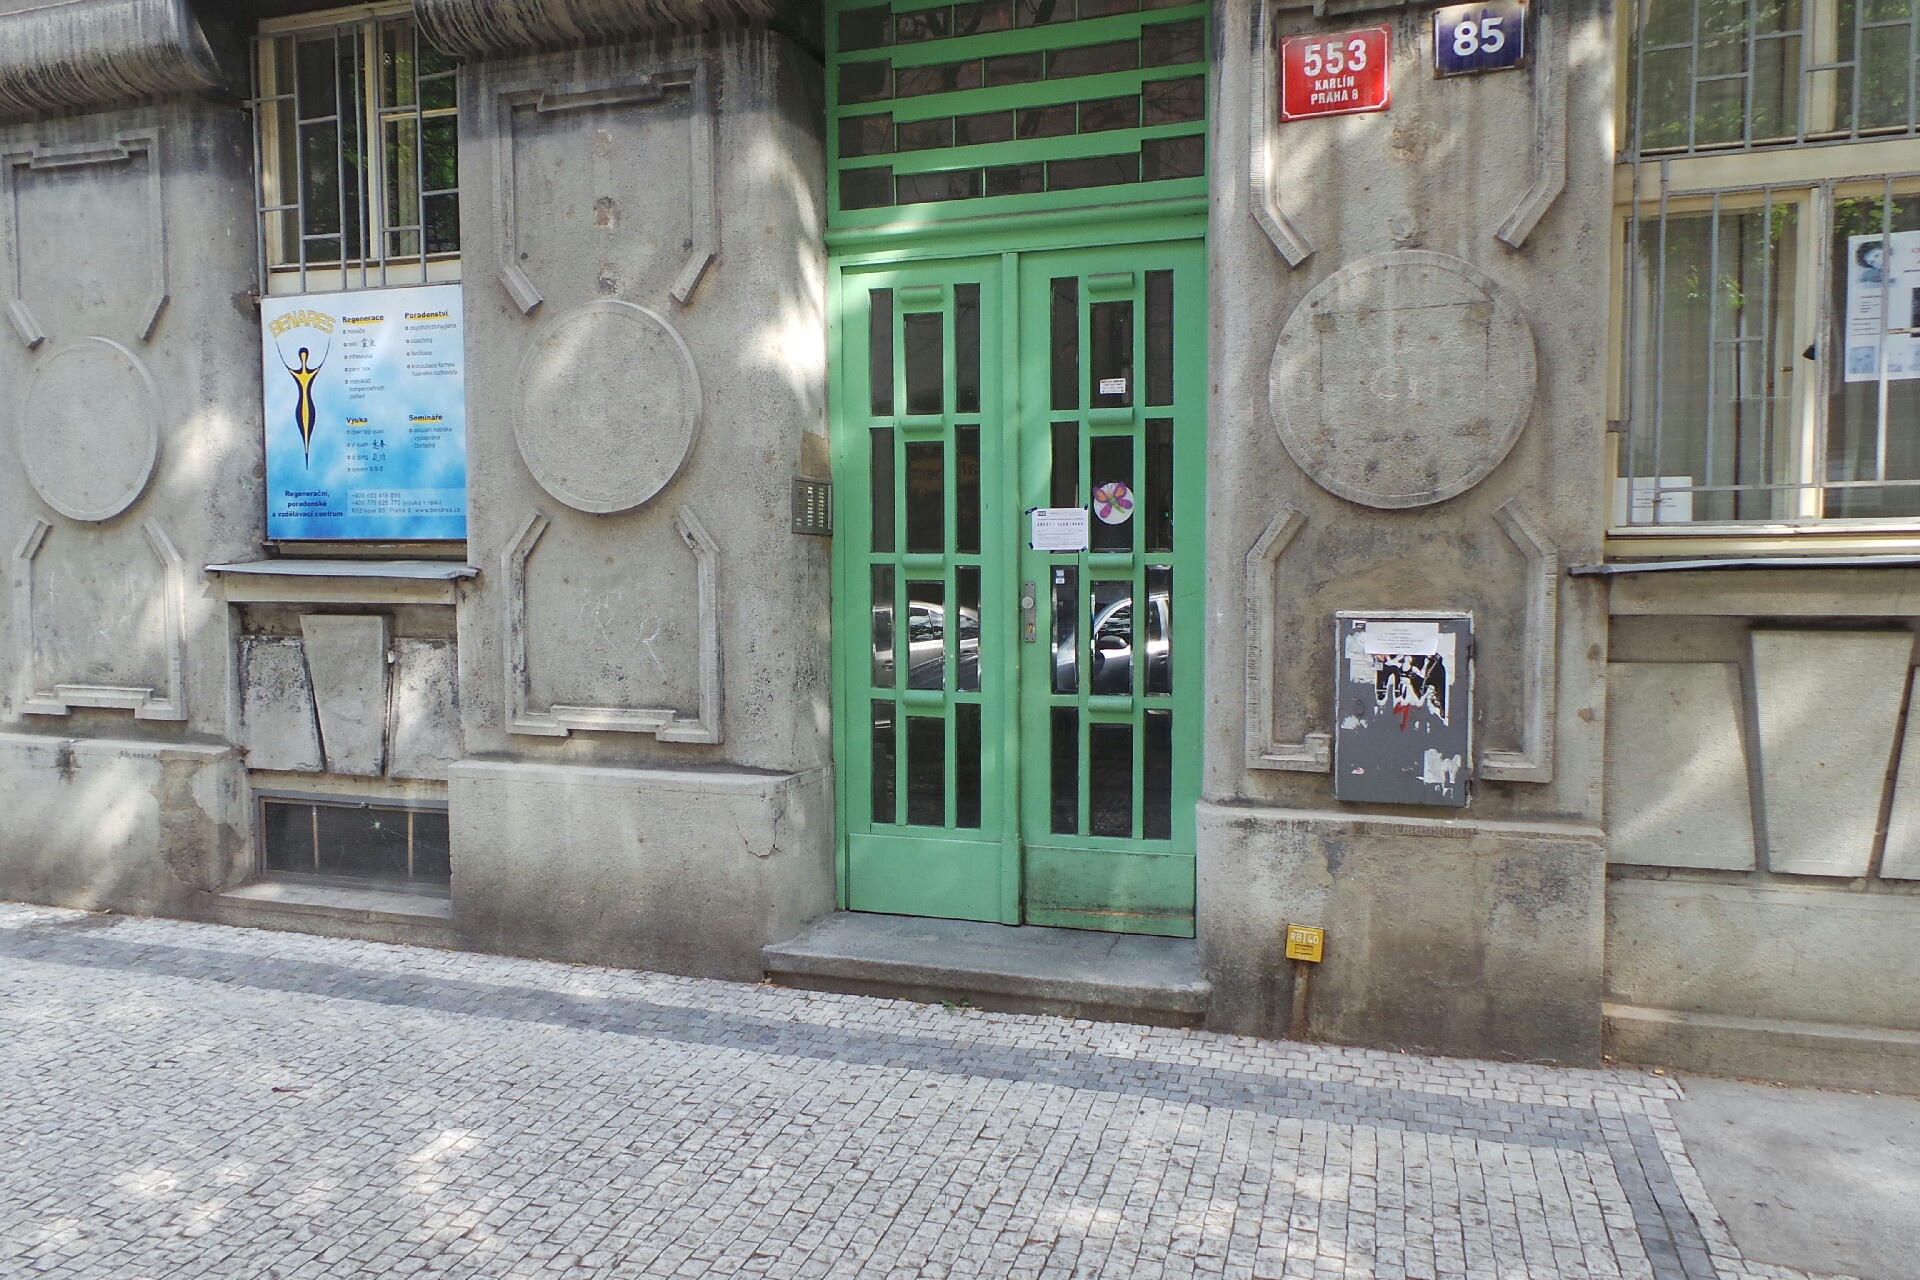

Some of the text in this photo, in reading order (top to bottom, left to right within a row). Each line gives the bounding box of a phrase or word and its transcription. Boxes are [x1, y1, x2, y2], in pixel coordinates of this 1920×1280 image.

[1453, 17, 1506, 56] 85
[1304, 39, 1367, 77] 553
[1314, 76, 1354, 92] KARLÍN
[1310, 88, 1358, 105] PRAHA 8
[268, 310, 336, 337] BENARES
[342, 314, 384, 324] Regenerace
